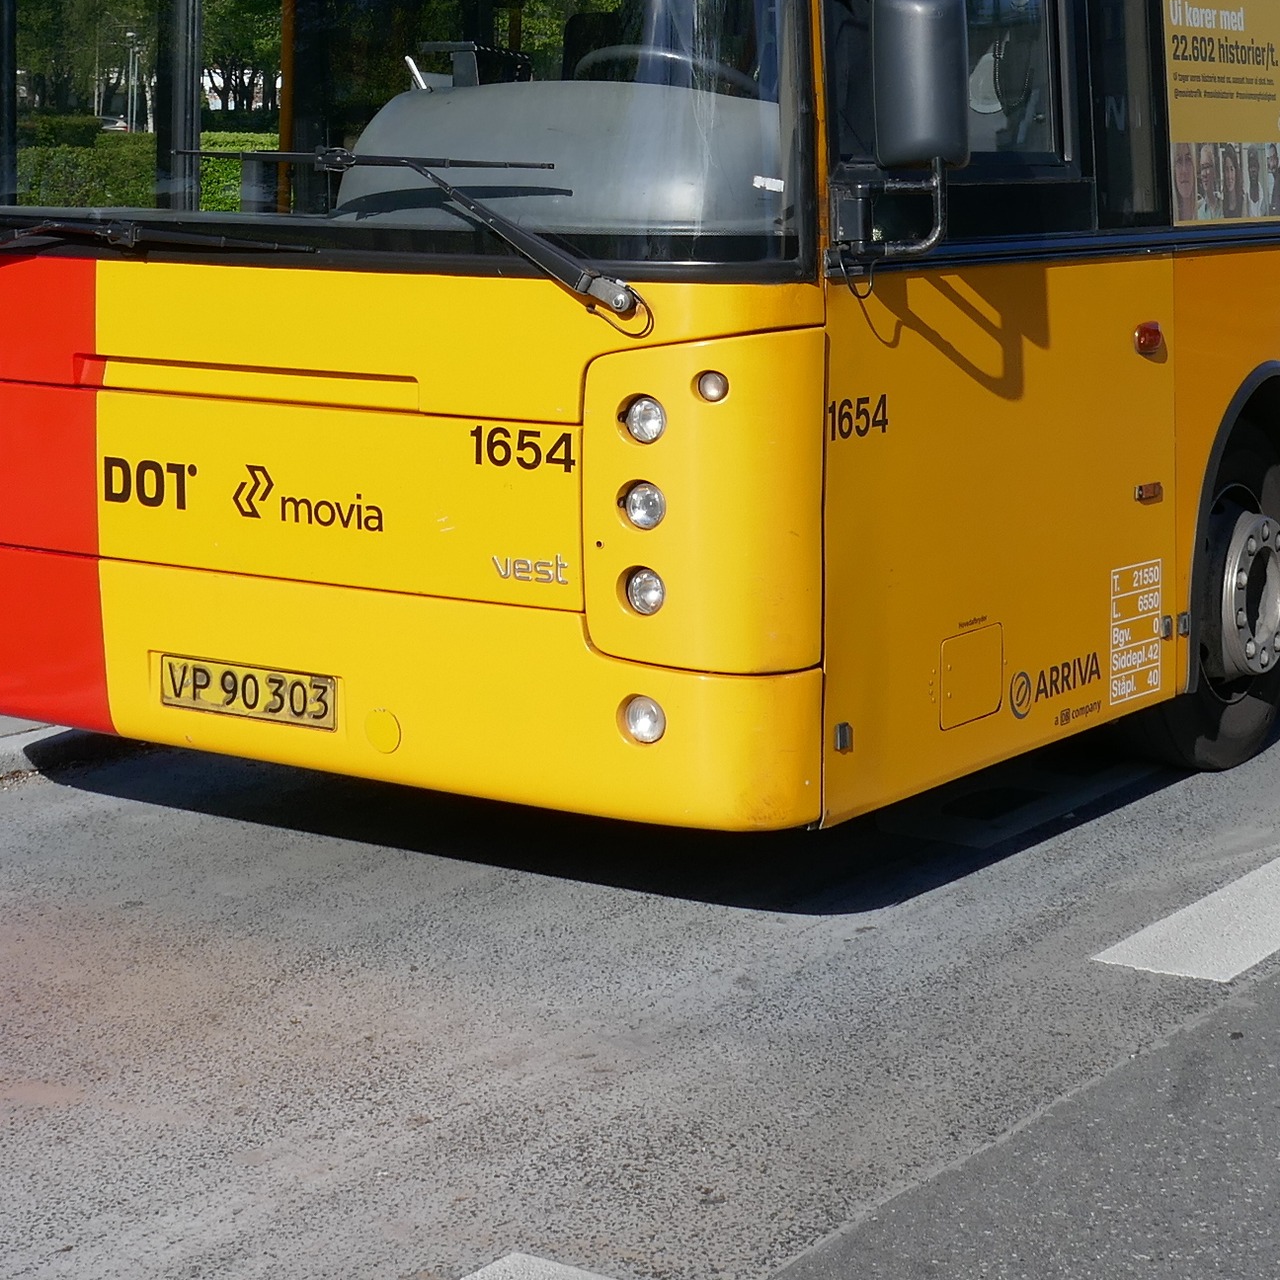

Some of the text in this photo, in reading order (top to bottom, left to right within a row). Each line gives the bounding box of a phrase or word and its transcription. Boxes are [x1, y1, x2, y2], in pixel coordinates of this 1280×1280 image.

[1185, 1, 1217, 29] kører
[1219, 7, 1245, 32] med
[1171, 34, 1279, 71] 22.602 historier/t.
[828, 393, 889, 442] 1654
[470, 425, 576, 473] 1654
[103, 456, 198, 510] DOT
[280, 493, 384, 533] movia
[492, 553, 569, 585] vest
[1113, 566, 1159, 592] T. 21550
[1113, 592, 1159, 618] L. 6550
[1113, 618, 1159, 646] Bgv. 0
[1112, 643, 1159, 671] Siddepl. 42
[168, 662, 329, 720] VP 90 303
[1034, 652, 1101, 703] ARRIVA
[1112, 669, 1159, 698] Ståpl. 40
[1054, 716, 1059, 726] a
[1072, 700, 1102, 720] company
